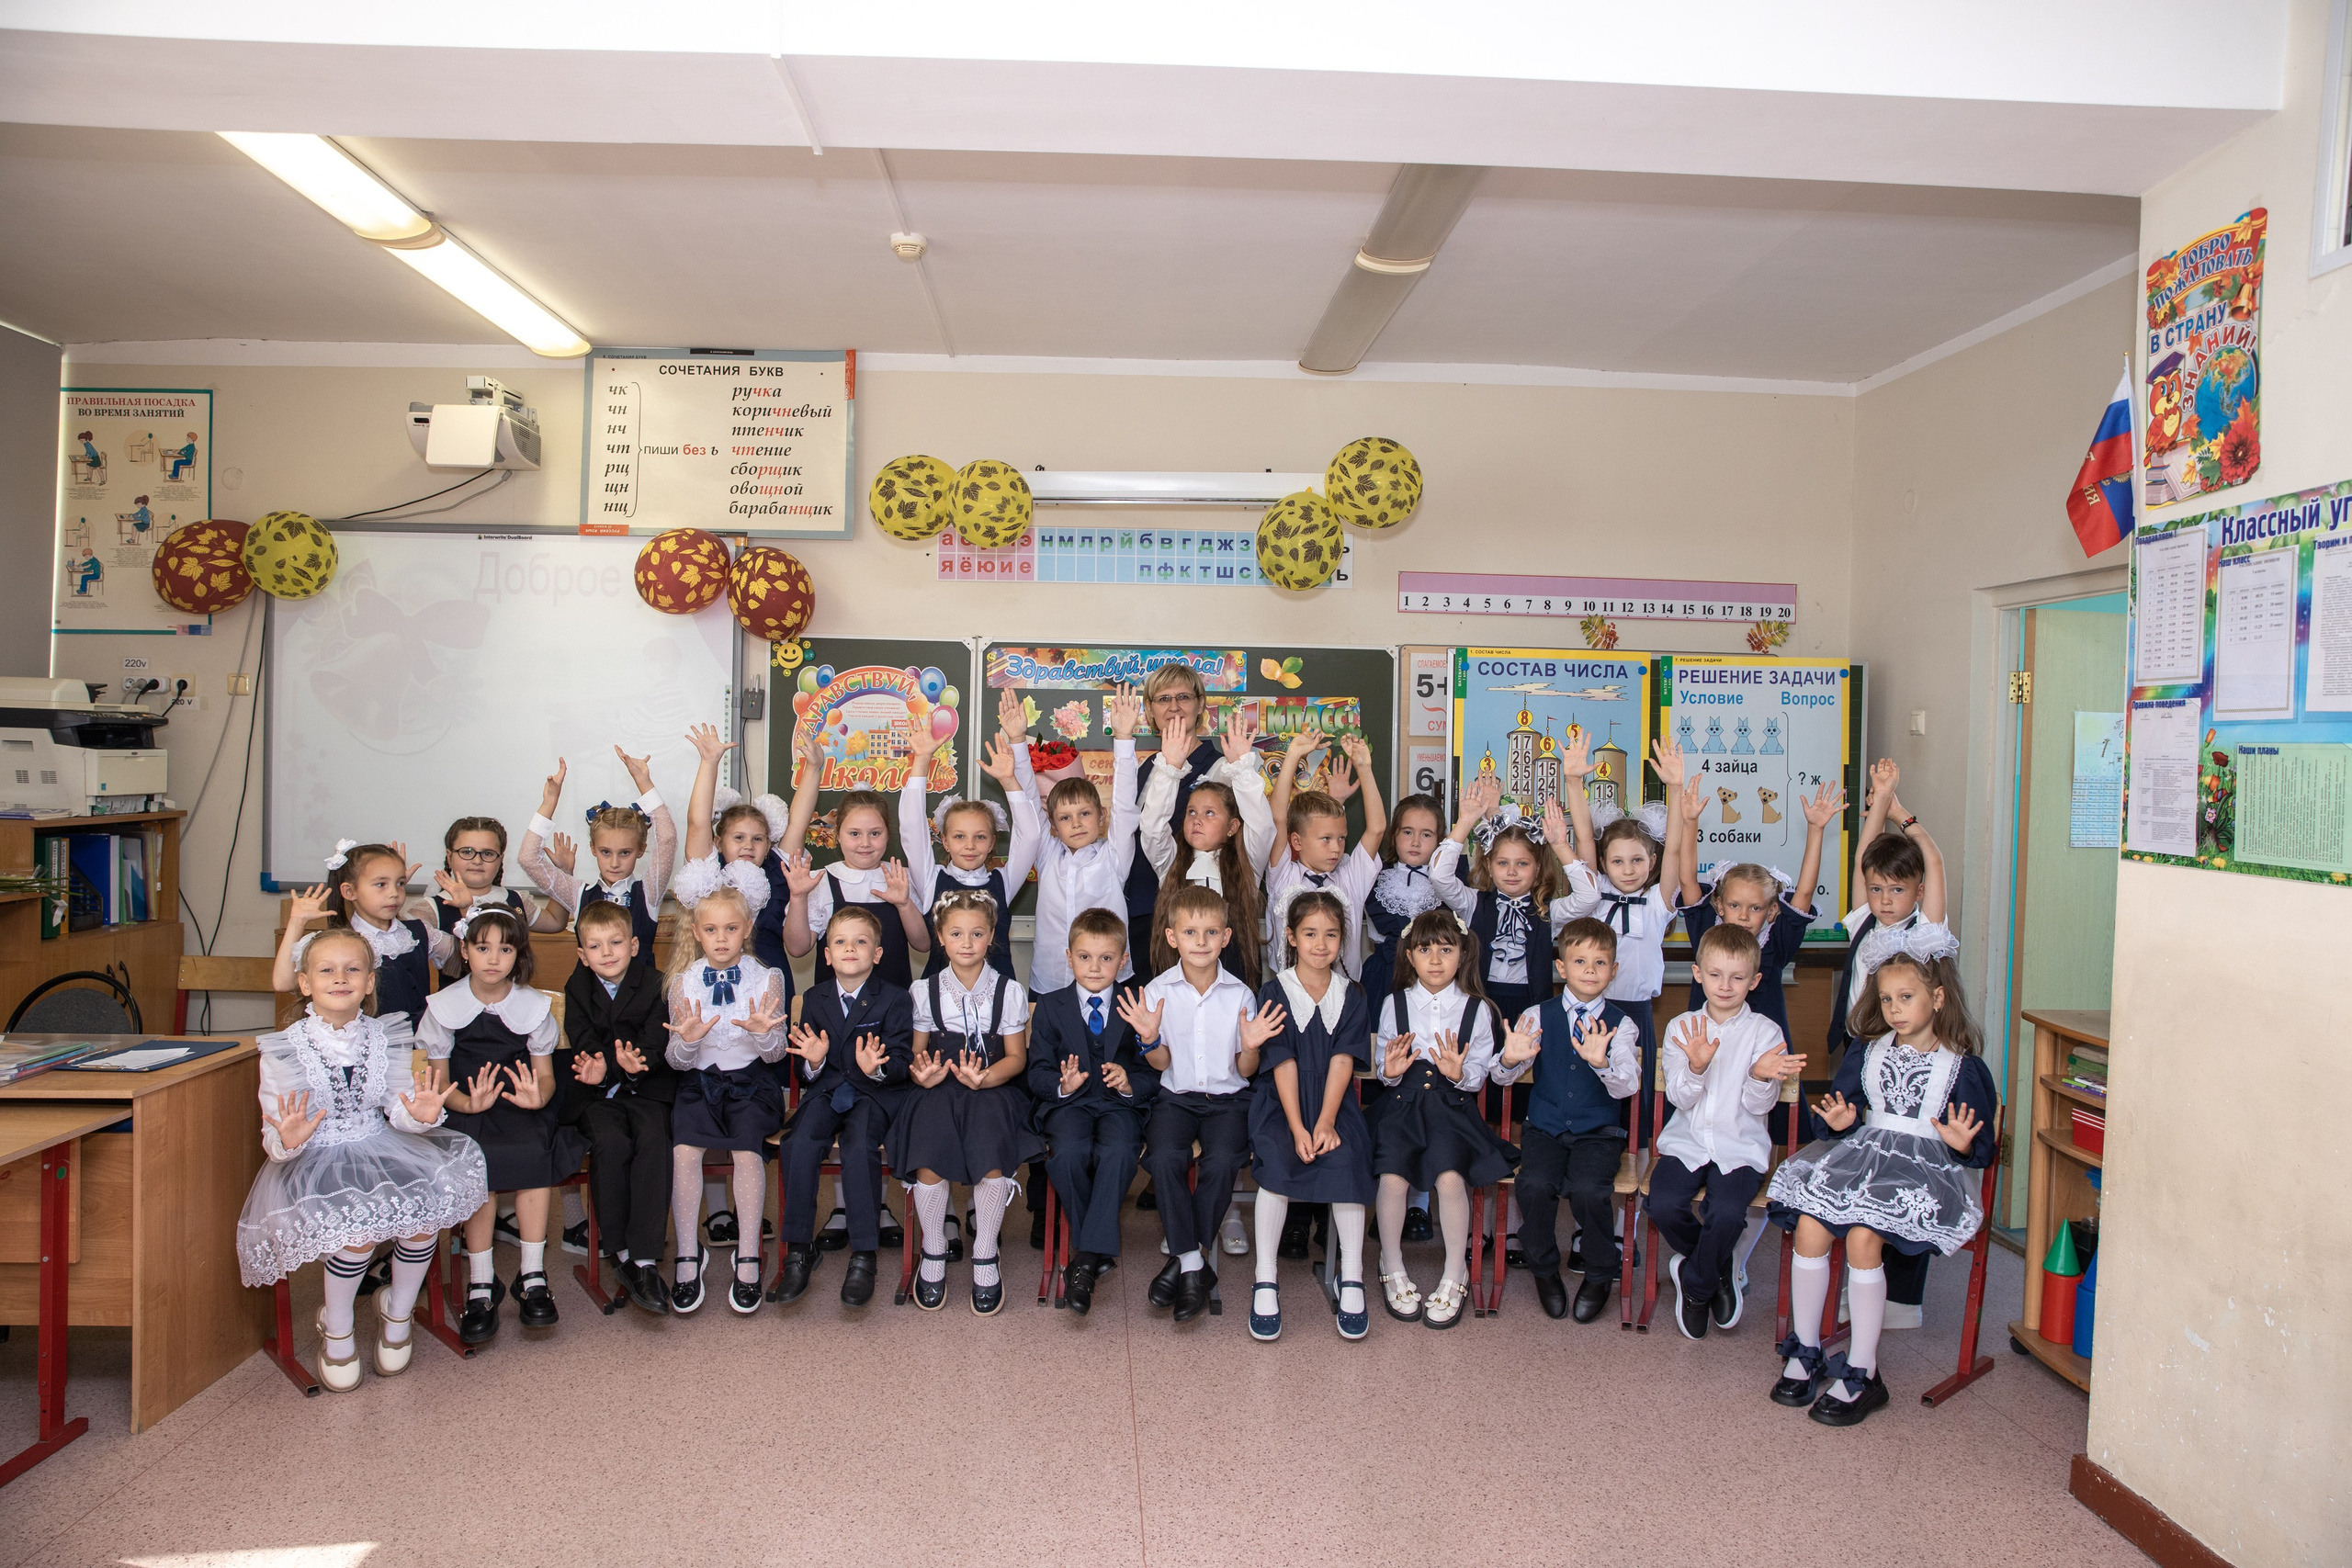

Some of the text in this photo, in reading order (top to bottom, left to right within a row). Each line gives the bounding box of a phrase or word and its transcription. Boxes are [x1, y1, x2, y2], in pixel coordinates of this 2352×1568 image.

[2178, 232, 2231, 275] ДОБРО
[2154, 247, 2254, 311] ПОЖАЛОВАТЬ
[2150, 301, 2228, 355] В СТРАНУ
[659, 365, 784, 377] СОЧЕТАНИЯ БУКВ
[2181, 322, 2256, 413] ЗНАНИЙ!
[608, 385, 628, 395] чк
[732, 386, 782, 400] ручка
[67, 397, 196, 408] ПРАВИЛЬНАЯ ПОСАДКА
[78, 407, 185, 418] ВО ВРЕМЯ ЗАНЯТИЙ
[608, 405, 628, 415] чн
[732, 404, 832, 420] коричневый
[607, 424, 627, 434] нч
[731, 426, 804, 437] птенчик
[605, 444, 630, 454] чт
[644, 444, 718, 456] пиши без ь
[731, 446, 792, 457] чтение
[605, 463, 629, 477] рщ
[730, 463, 802, 479] сборщик
[605, 482, 629, 495] щн
[729, 481, 804, 496] овощной
[604, 502, 628, 515] нщ
[729, 502, 833, 518] барабанщик
[2222, 497, 2320, 546] Классный
[2135, 532, 2173, 546] Поздравляем
[2312, 537, 2340, 550] Творим
[2218, 555, 2251, 568] Наш класс
[473, 551, 621, 607] Доброе
[1405, 595, 1791, 618] 1 2 3 4 5 6 7 8 9 10 11 12 13 14 15 16 17 18 19 20
[125, 659, 147, 668] 220v
[1005, 655, 1145, 684] Здравствуй,
[1477, 661, 1629, 679] СОСТАВ ЧИСЛА
[1679, 670, 1763, 684] РЕШЕНИЕ
[1769, 671, 1836, 687] ЗАДАЧИ
[797, 671, 918, 739] ДРАВСТВУЙ,
[1679, 690, 1836, 708] Условие Вопрос
[2132, 698, 2187, 710] Правила поведения
[1521, 711, 1528, 726] 8
[1513, 736, 1531, 749] 1 7
[1544, 738, 1551, 750] 6
[2238, 745, 2279, 755] Наши планы
[1416, 753, 1446, 762] УМЕНЬШАЕМО
[1512, 751, 1531, 764] 2 6
[1512, 765, 1531, 778] 3 5
[1540, 762, 1555, 776] 1 5
[1600, 762, 1607, 776] 4
[1702, 760, 1758, 775] 4 зайца
[1538, 778, 1555, 791] 2 4
[1798, 772, 1806, 785] ?
[1511, 781, 1531, 794] 4 4
[1597, 785, 1613, 798] 1 3
[1710, 829, 1761, 843] собаки
